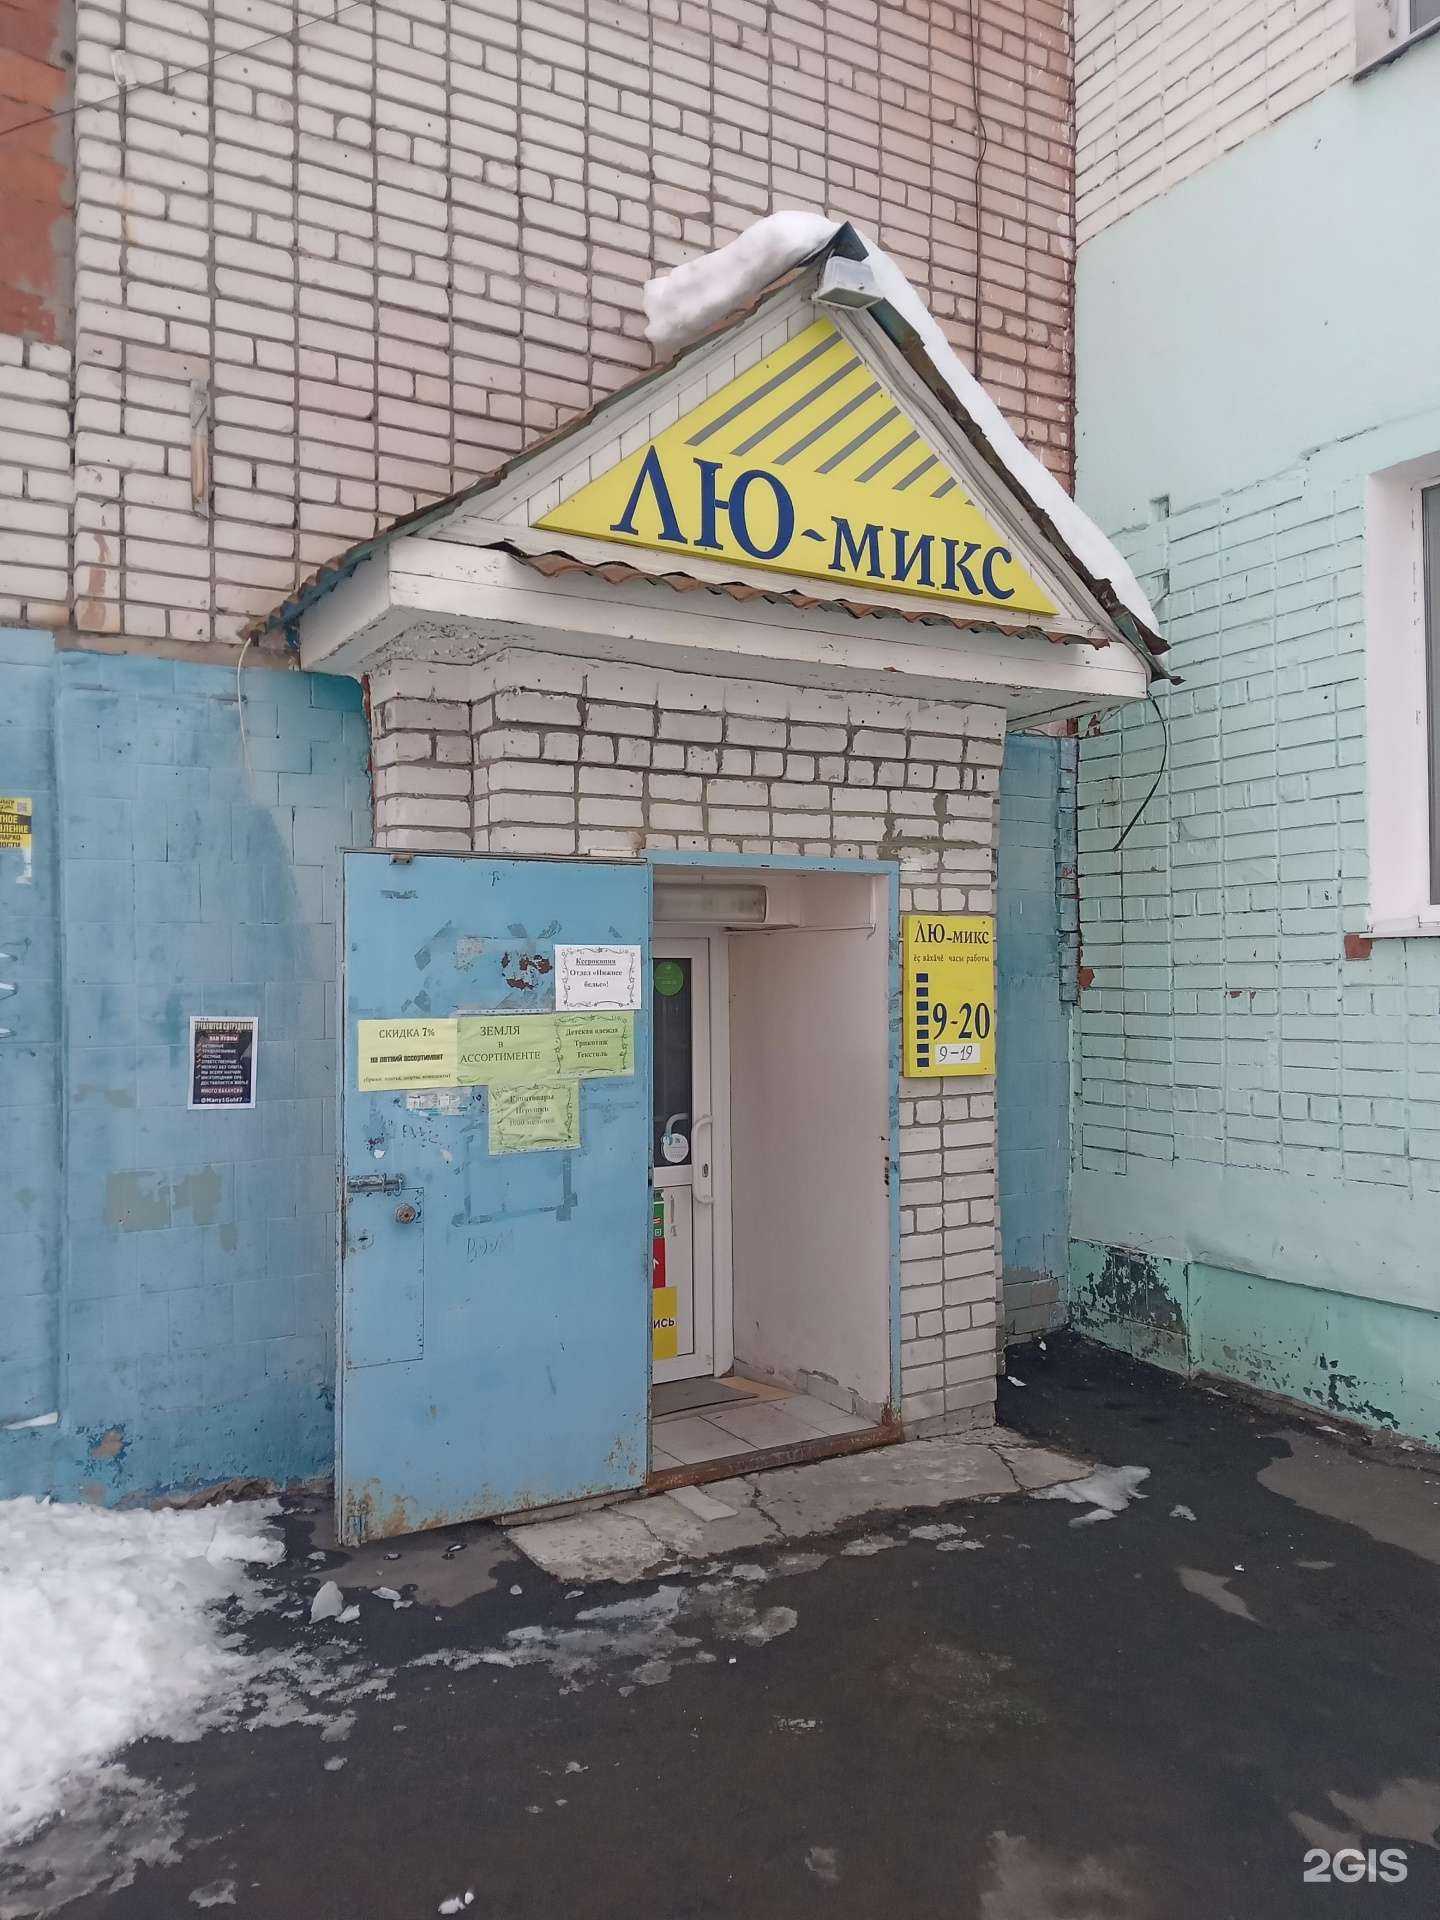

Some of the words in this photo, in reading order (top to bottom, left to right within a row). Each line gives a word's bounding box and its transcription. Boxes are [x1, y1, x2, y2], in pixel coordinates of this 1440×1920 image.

[966, 953, 990, 963] работы
[569, 969, 591, 977] Отдел
[932, 1002, 990, 1040] 9-20
[379, 1028, 420, 1039] СКИДКА
[422, 1027, 436, 1038] 7%
[480, 1025, 521, 1036] ЗЕМЛЯ
[565, 1028, 593, 1036] Детская
[403, 1053, 443, 1063] ассортимент
[460, 1051, 541, 1063] АССОРТИМЕНТЕ
[577, 1051, 608, 1059] Текстиль
